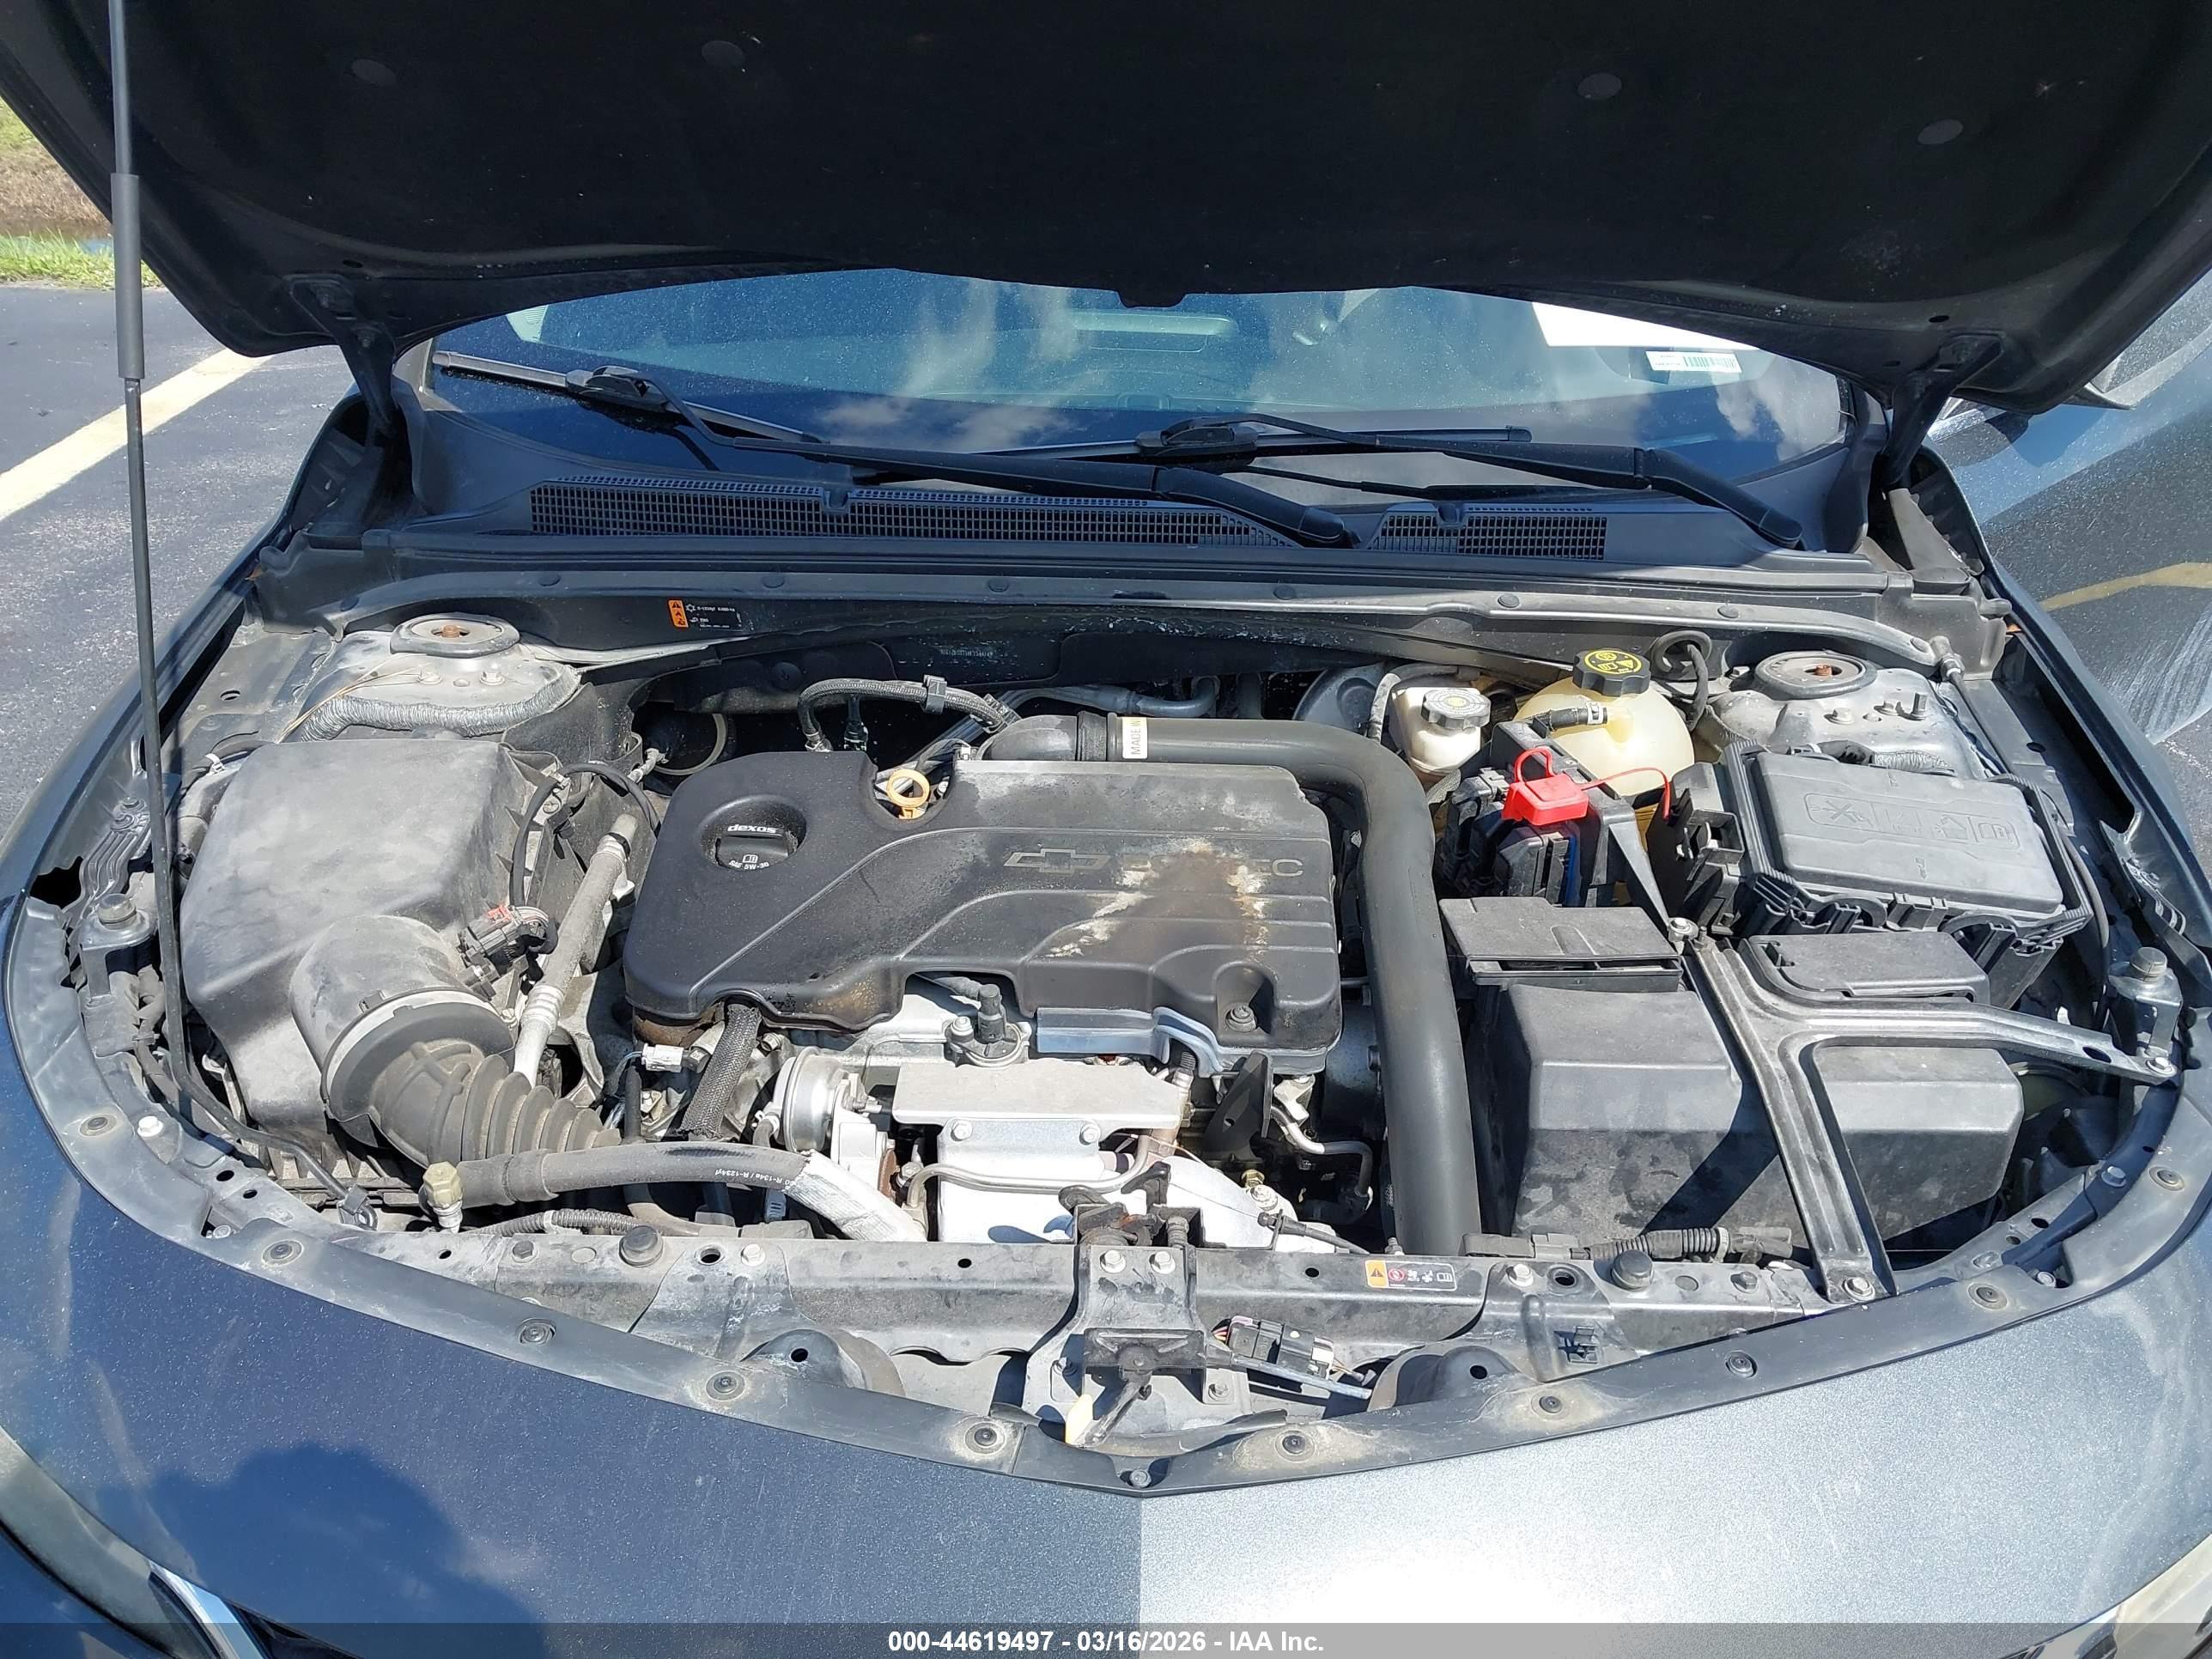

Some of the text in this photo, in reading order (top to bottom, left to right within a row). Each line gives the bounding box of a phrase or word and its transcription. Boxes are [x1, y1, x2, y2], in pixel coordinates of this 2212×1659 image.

[1130, 728, 1141, 755] MADE
[727, 824, 777, 834] dexos
[728, 860, 770, 870] SAE 5W-30
[714, 1169, 750, 1178] R-1234yf
[756, 1173, 783, 1184] R-134a
